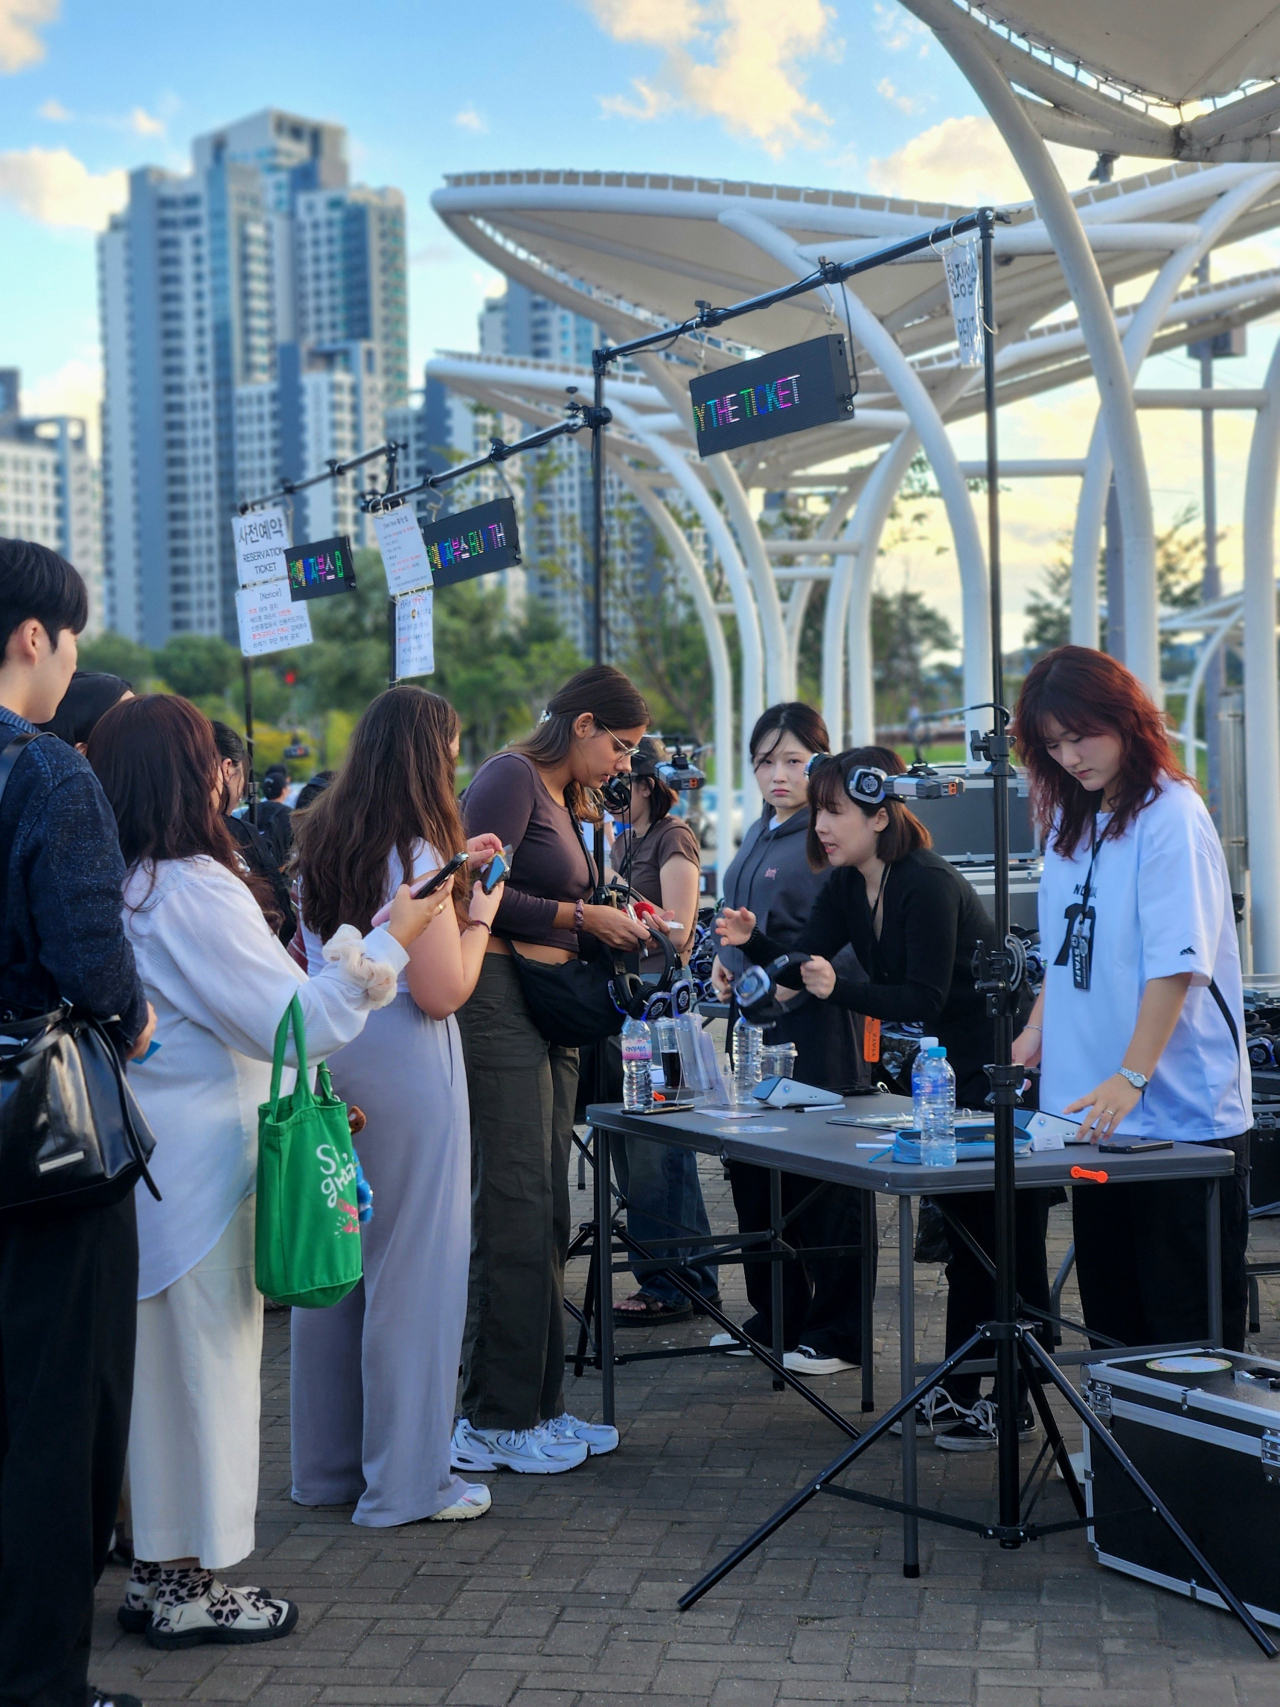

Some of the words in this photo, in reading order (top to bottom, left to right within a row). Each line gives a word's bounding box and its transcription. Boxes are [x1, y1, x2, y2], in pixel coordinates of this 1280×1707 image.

[706, 393, 740, 428] THE
[739, 374, 800, 418] TICKET
[239, 518, 284, 546] 사전예약
[242, 547, 284, 563] RESERVATION
[254, 562, 277, 575] TICKET
[259, 588, 282, 602] [Notice]
[1074, 948, 1082, 983] STAFF
